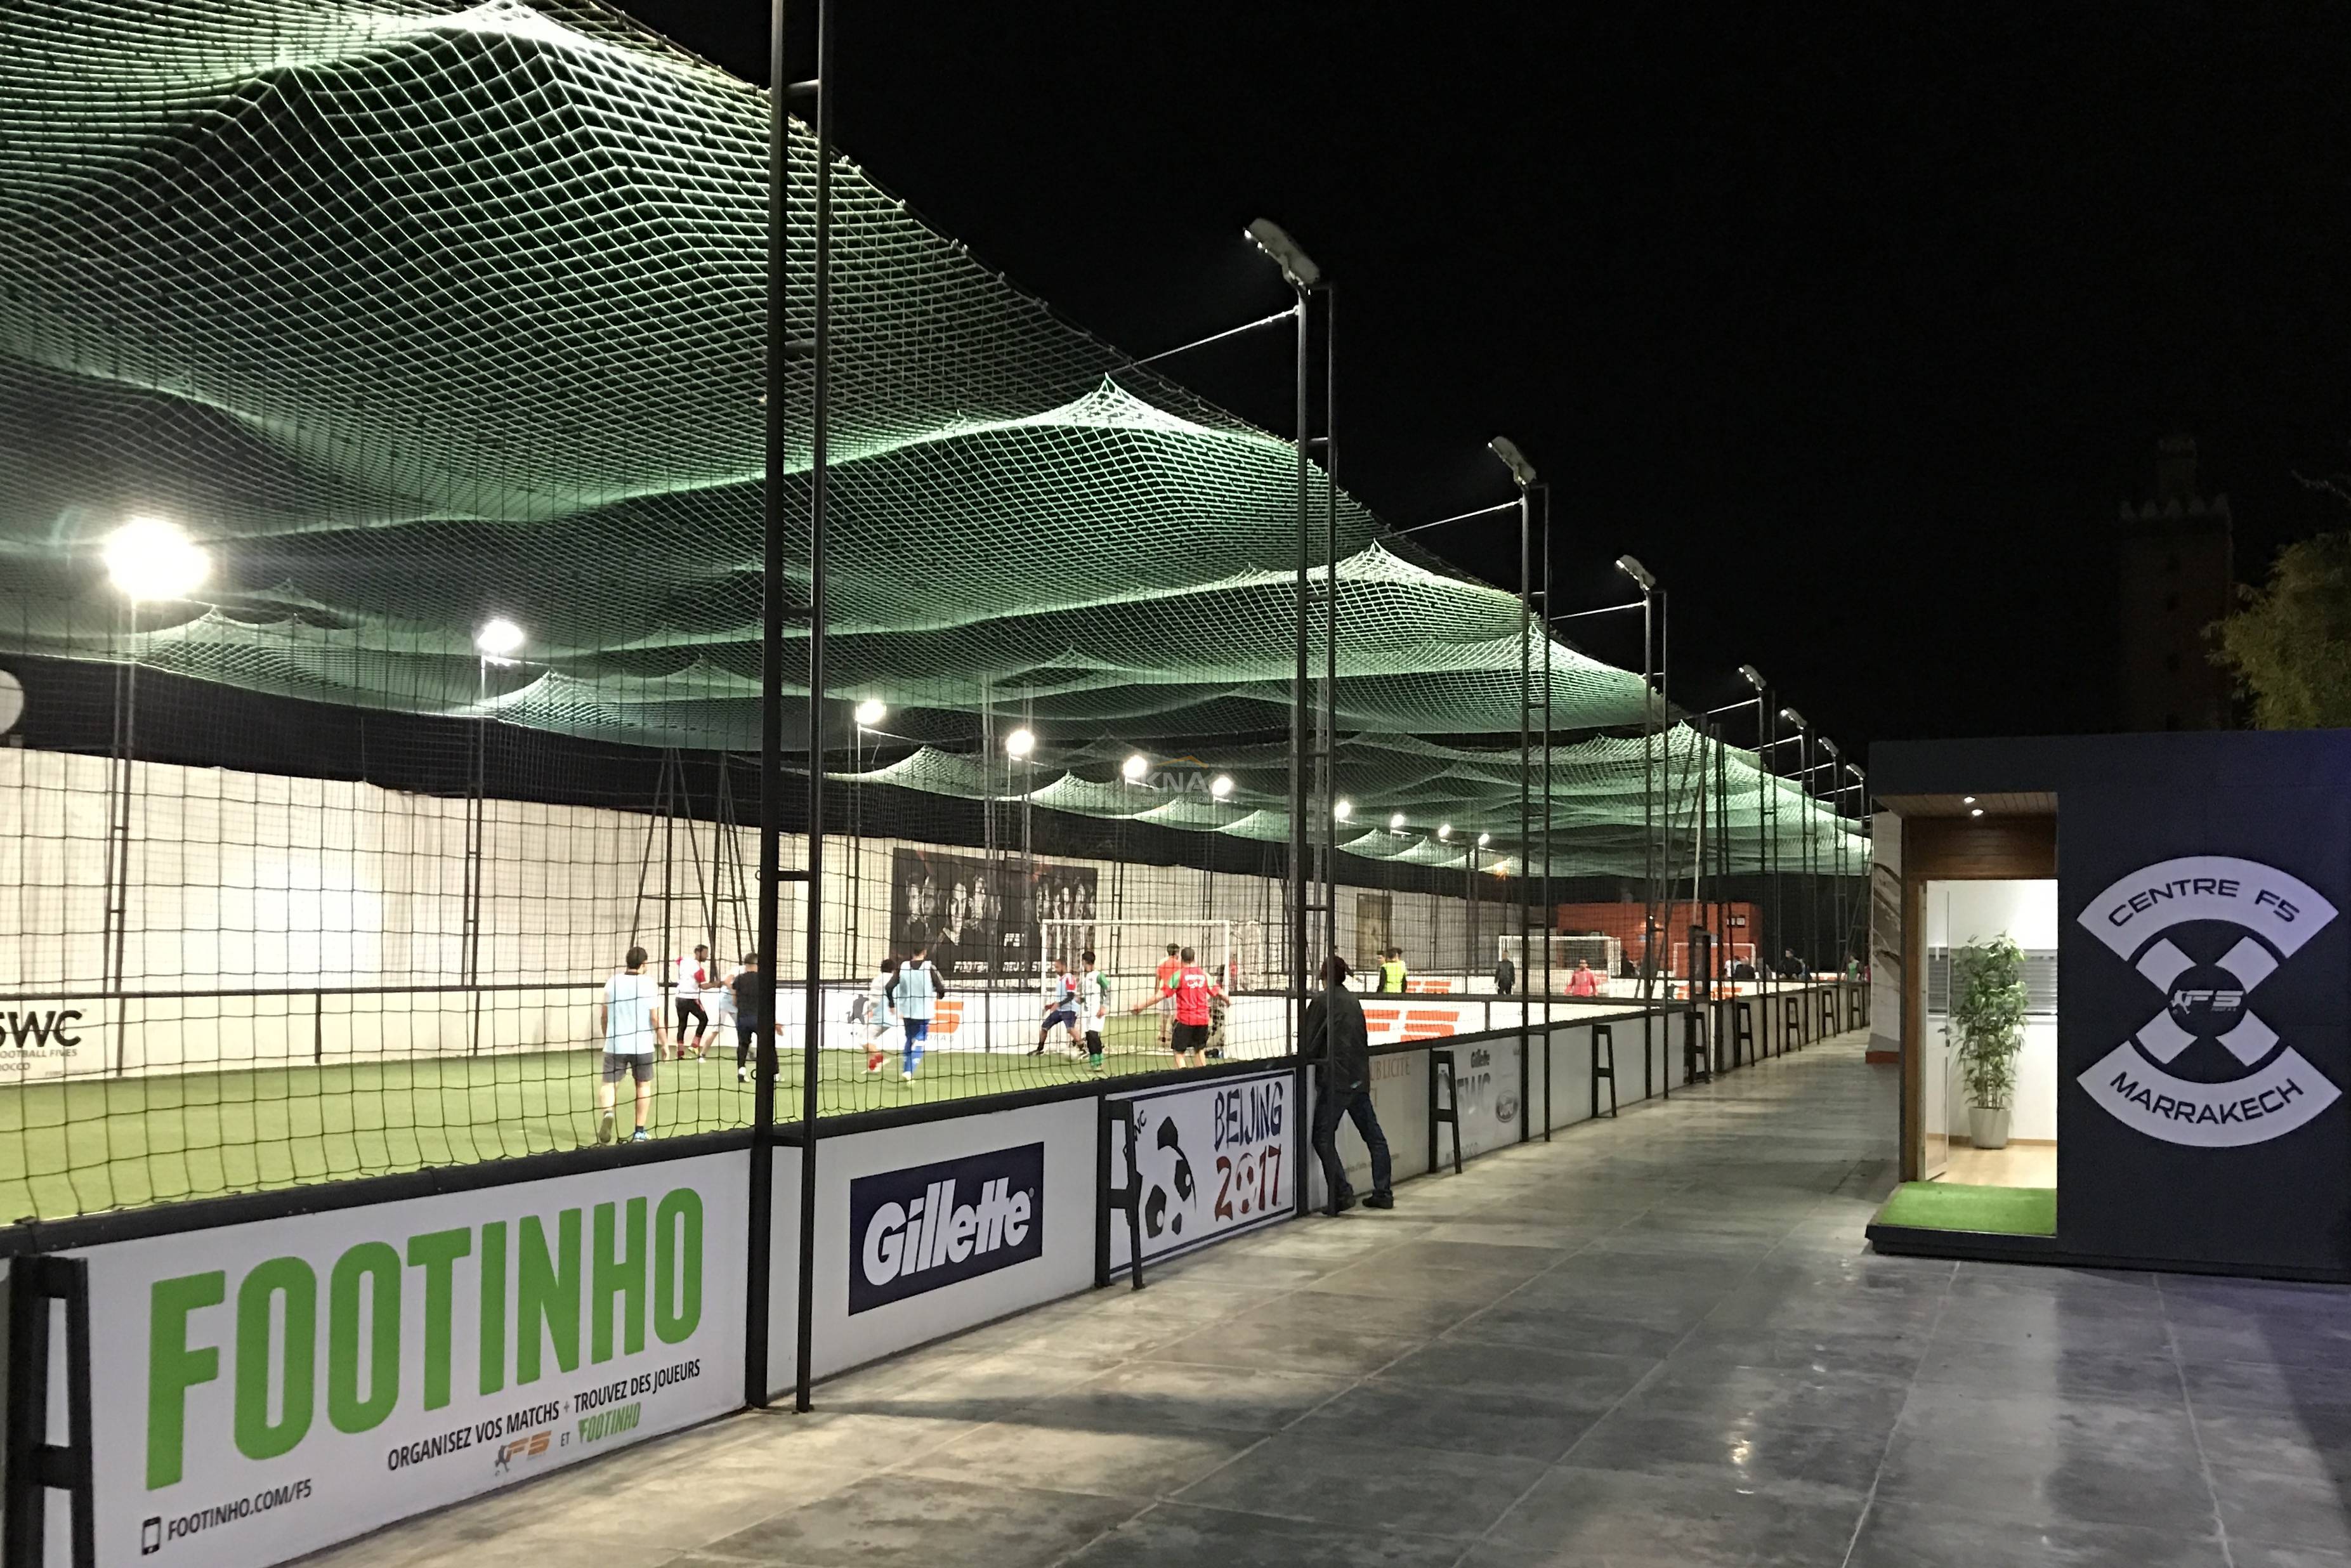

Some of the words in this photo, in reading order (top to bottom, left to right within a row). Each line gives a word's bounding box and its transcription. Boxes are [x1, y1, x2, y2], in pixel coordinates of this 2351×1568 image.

[2108, 878, 2241, 927] CENTRE
[2255, 889, 2300, 922] F5
[2184, 990, 2244, 1007] F5
[0, 1010, 82, 1048] WC
[0, 1050, 46, 1059] OOTBALL
[0, 1062, 30, 1071] OCCO
[1214, 1081, 1283, 1152] BEIJING
[2110, 1071, 2304, 1124] MARRAKECH
[1215, 1144, 1281, 1222] 2017
[863, 1177, 1031, 1286] Gillette
[147, 1188, 702, 1490] FOOTINHO
[388, 1427, 471, 1471] ORGANISEZ
[475, 1416, 502, 1441] VOS
[507, 1401, 560, 1434] MATCHS
[573, 1380, 627, 1413] TROUVEZ
[631, 1374, 652, 1397] DES
[653, 1359, 701, 1394] JOUEURS
[561, 1432, 570, 1447] ET
[578, 1402, 641, 1444] FOOTINHO
[167, 1478, 312, 1541] FOOTINHO.COM/F5
